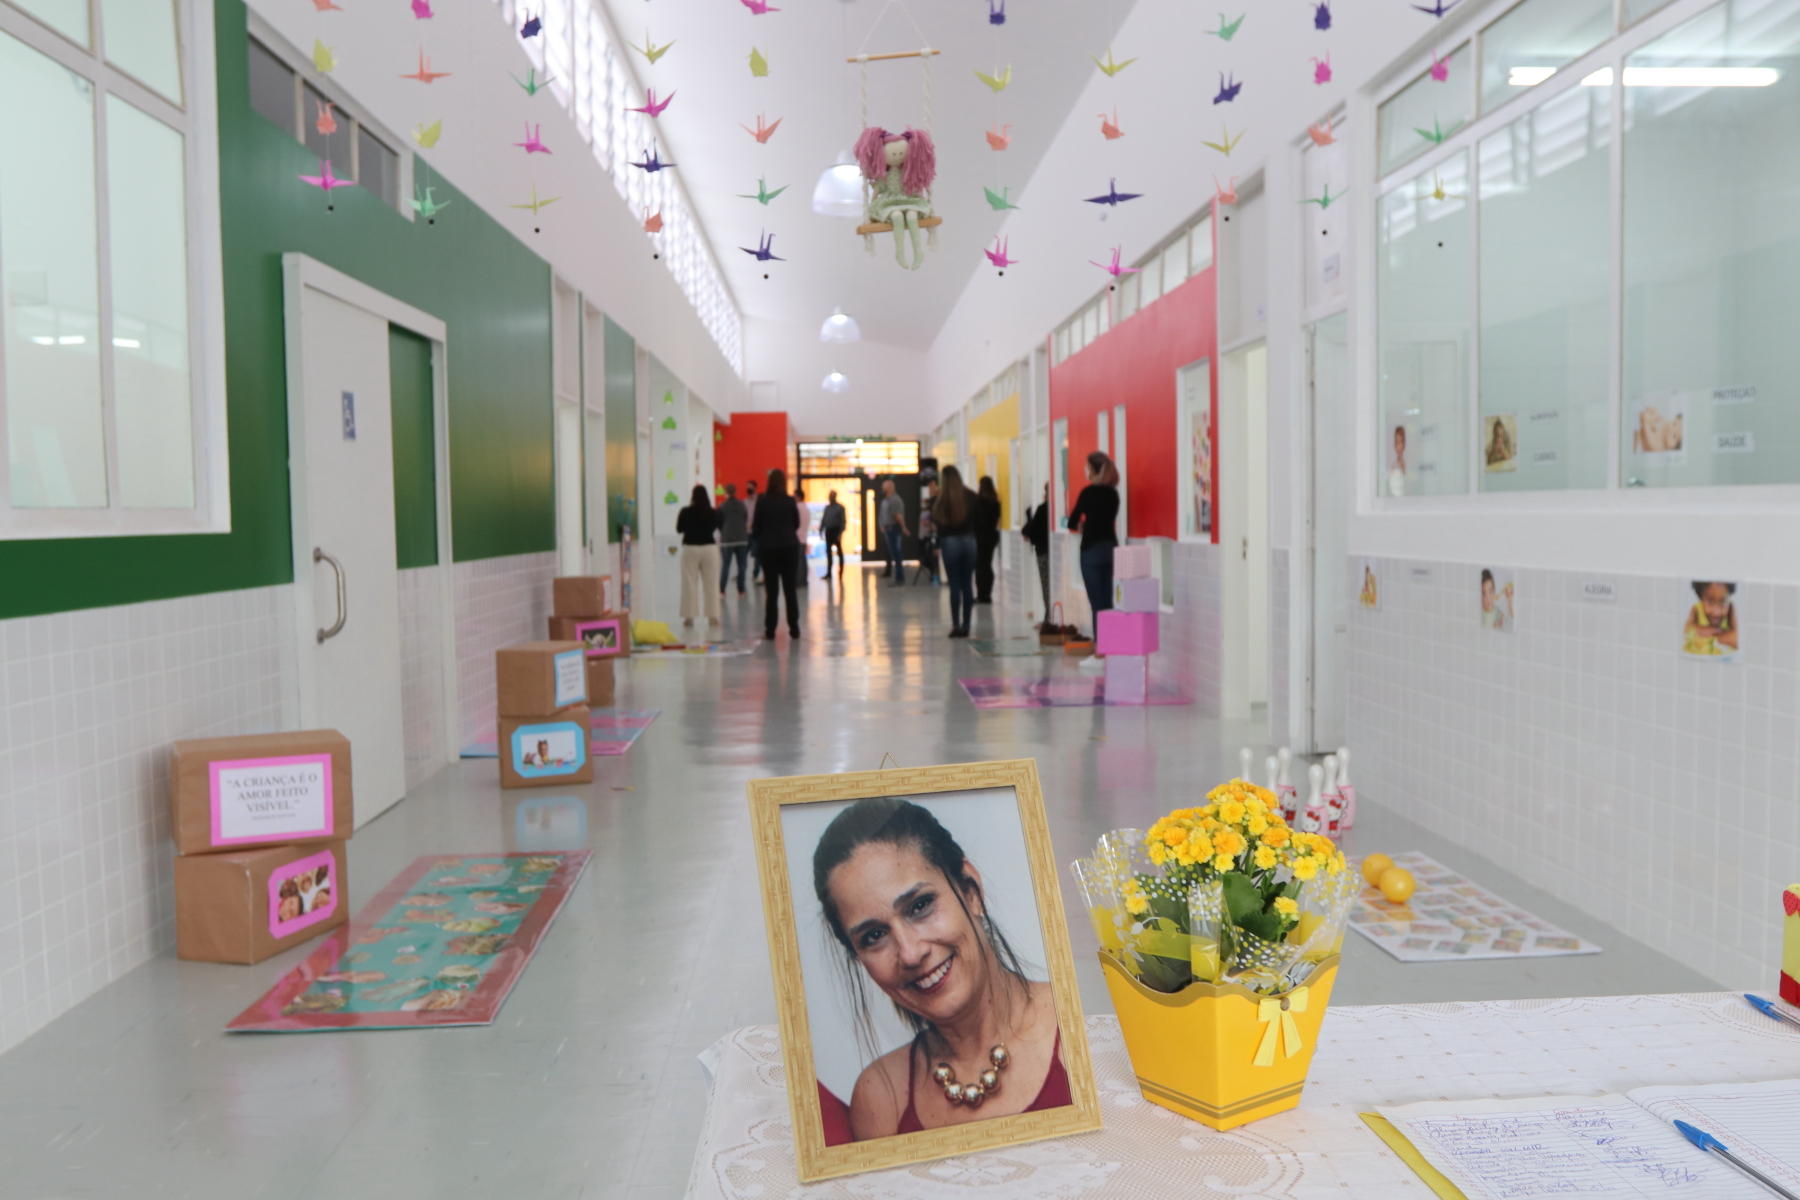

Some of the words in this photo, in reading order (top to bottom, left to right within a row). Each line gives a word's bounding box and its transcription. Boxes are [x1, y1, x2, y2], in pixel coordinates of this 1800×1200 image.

[243, 775, 297, 787] CRIANÇA
[308, 773, 318, 783] O
[237, 789, 273, 801] AMOR
[275, 786, 309, 798] FEITO
